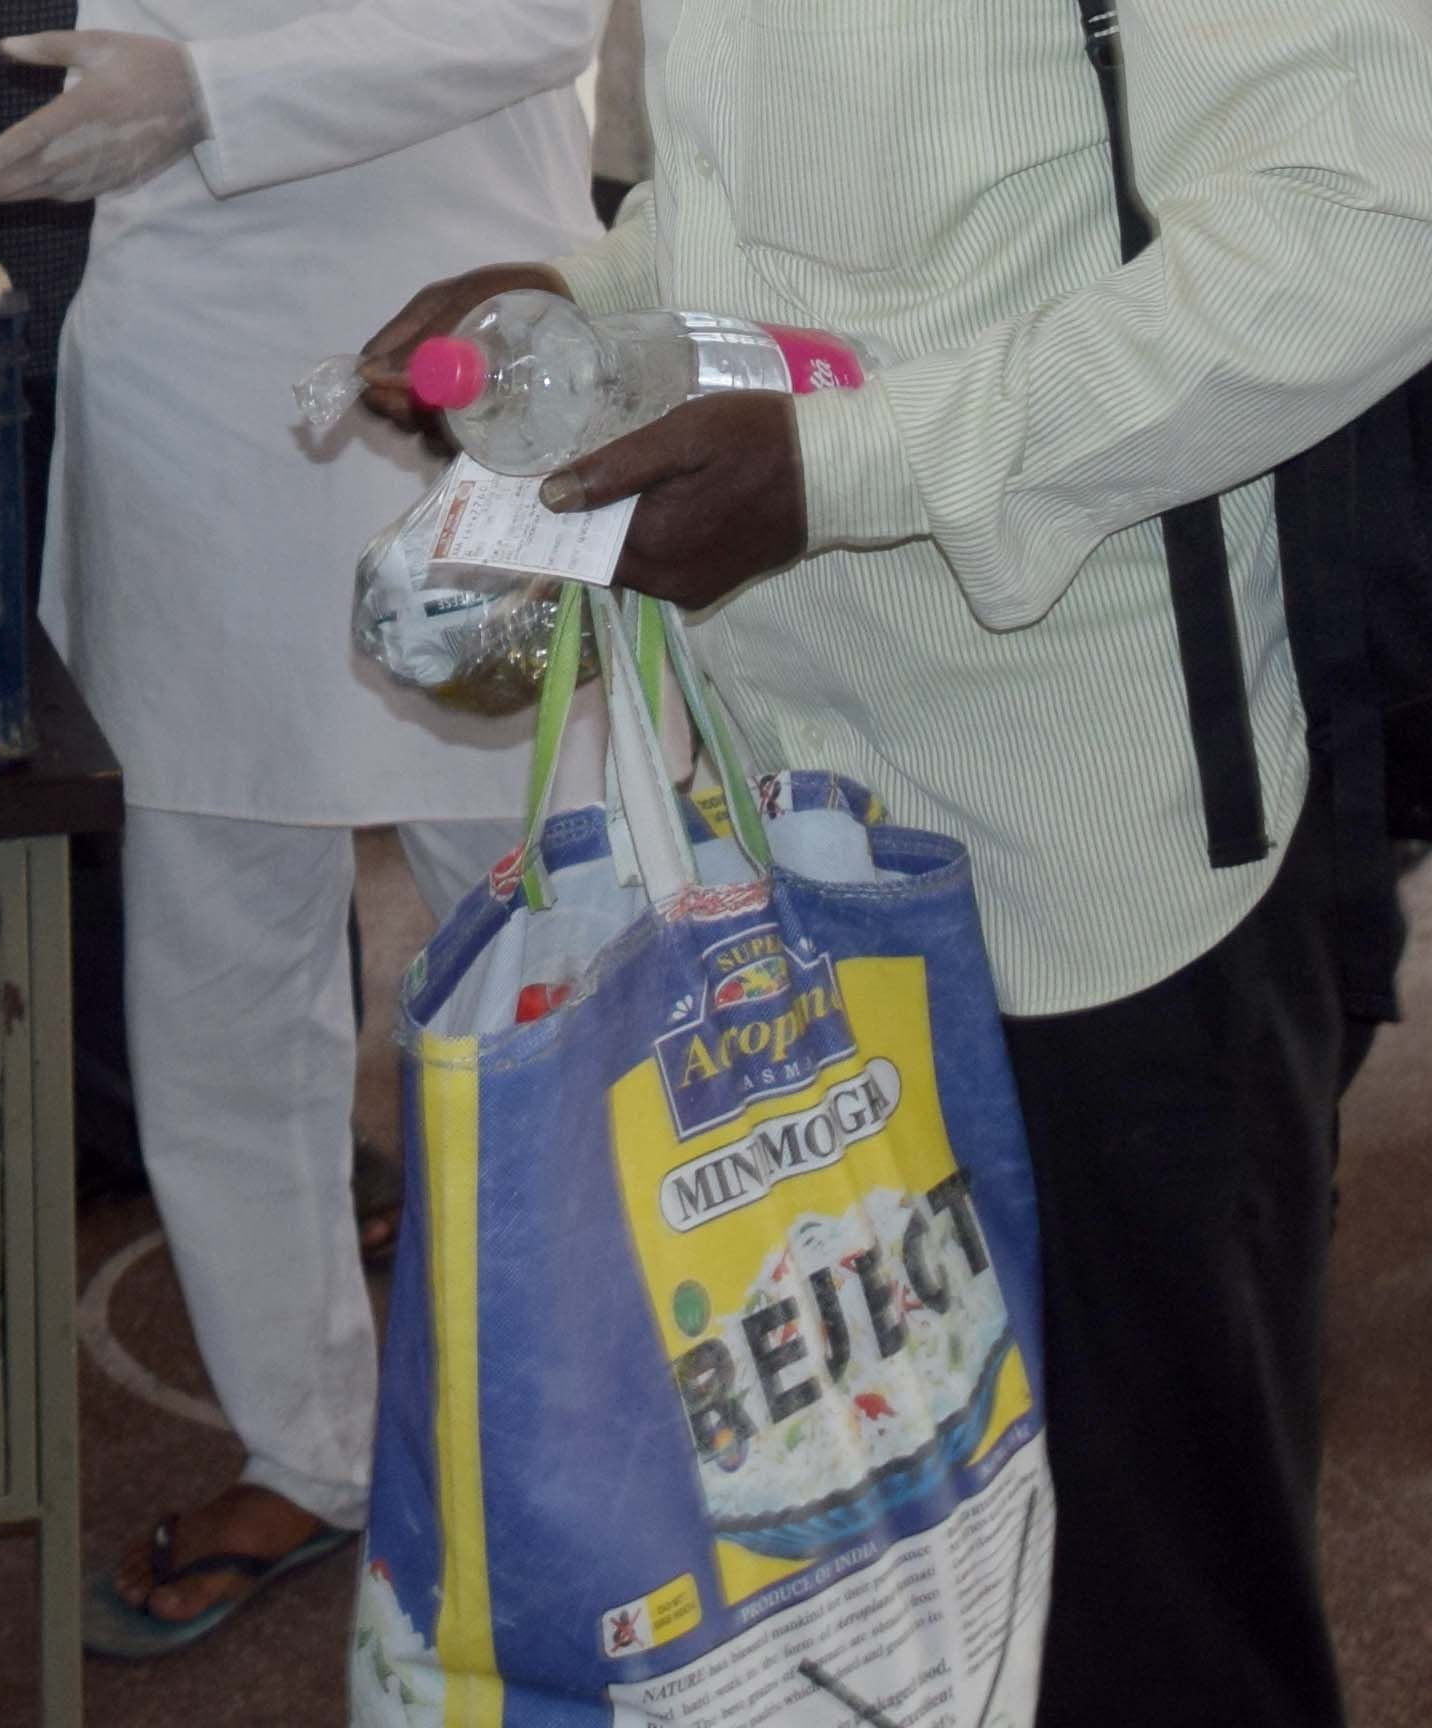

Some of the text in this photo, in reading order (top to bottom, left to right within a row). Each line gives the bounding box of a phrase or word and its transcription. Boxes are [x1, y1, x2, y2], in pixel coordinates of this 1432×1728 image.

[717, 934, 784, 972] SUPE
[670, 1166, 991, 1464] REJECT
[642, 1666, 707, 1705] NATURE
